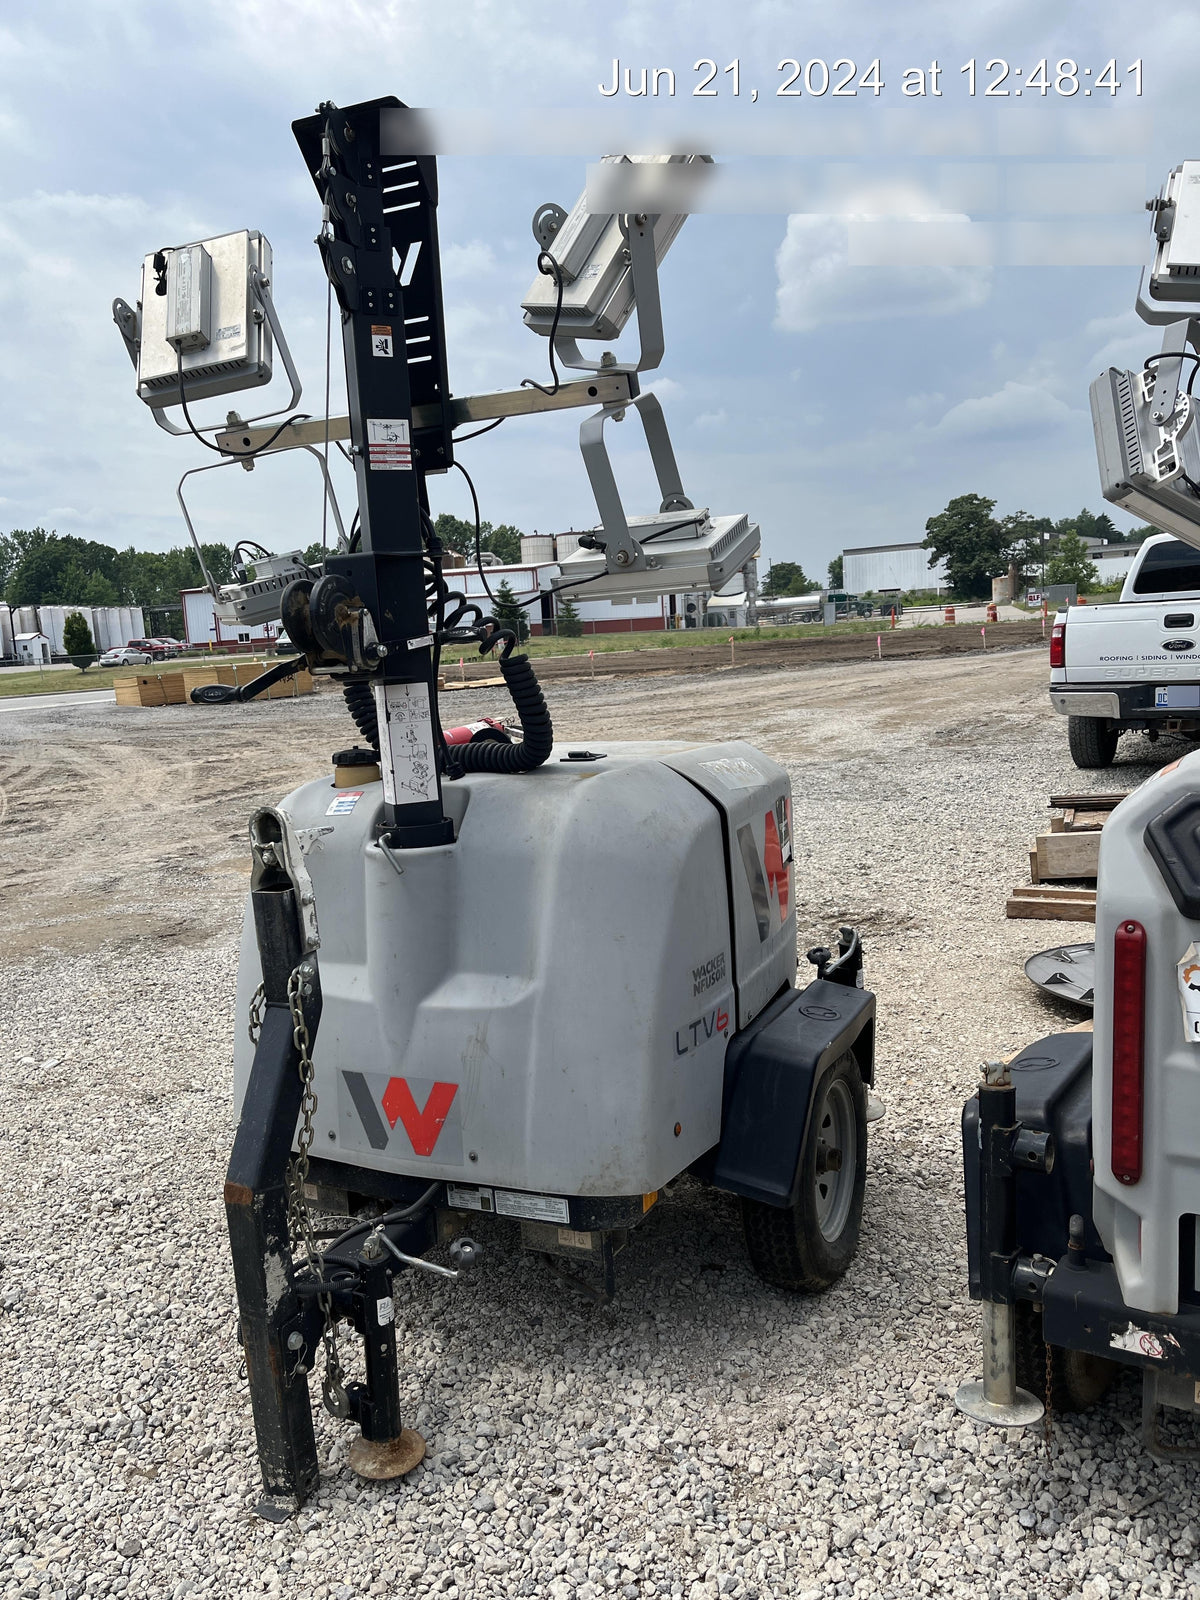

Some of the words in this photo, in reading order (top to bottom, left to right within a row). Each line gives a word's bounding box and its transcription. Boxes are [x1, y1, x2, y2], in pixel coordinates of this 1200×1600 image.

[1105, 668, 1178, 679] SUPER
[692, 952, 725, 982] WACKER
[693, 965, 726, 997] NEUSON
[675, 1007, 729, 1056] LTV6
